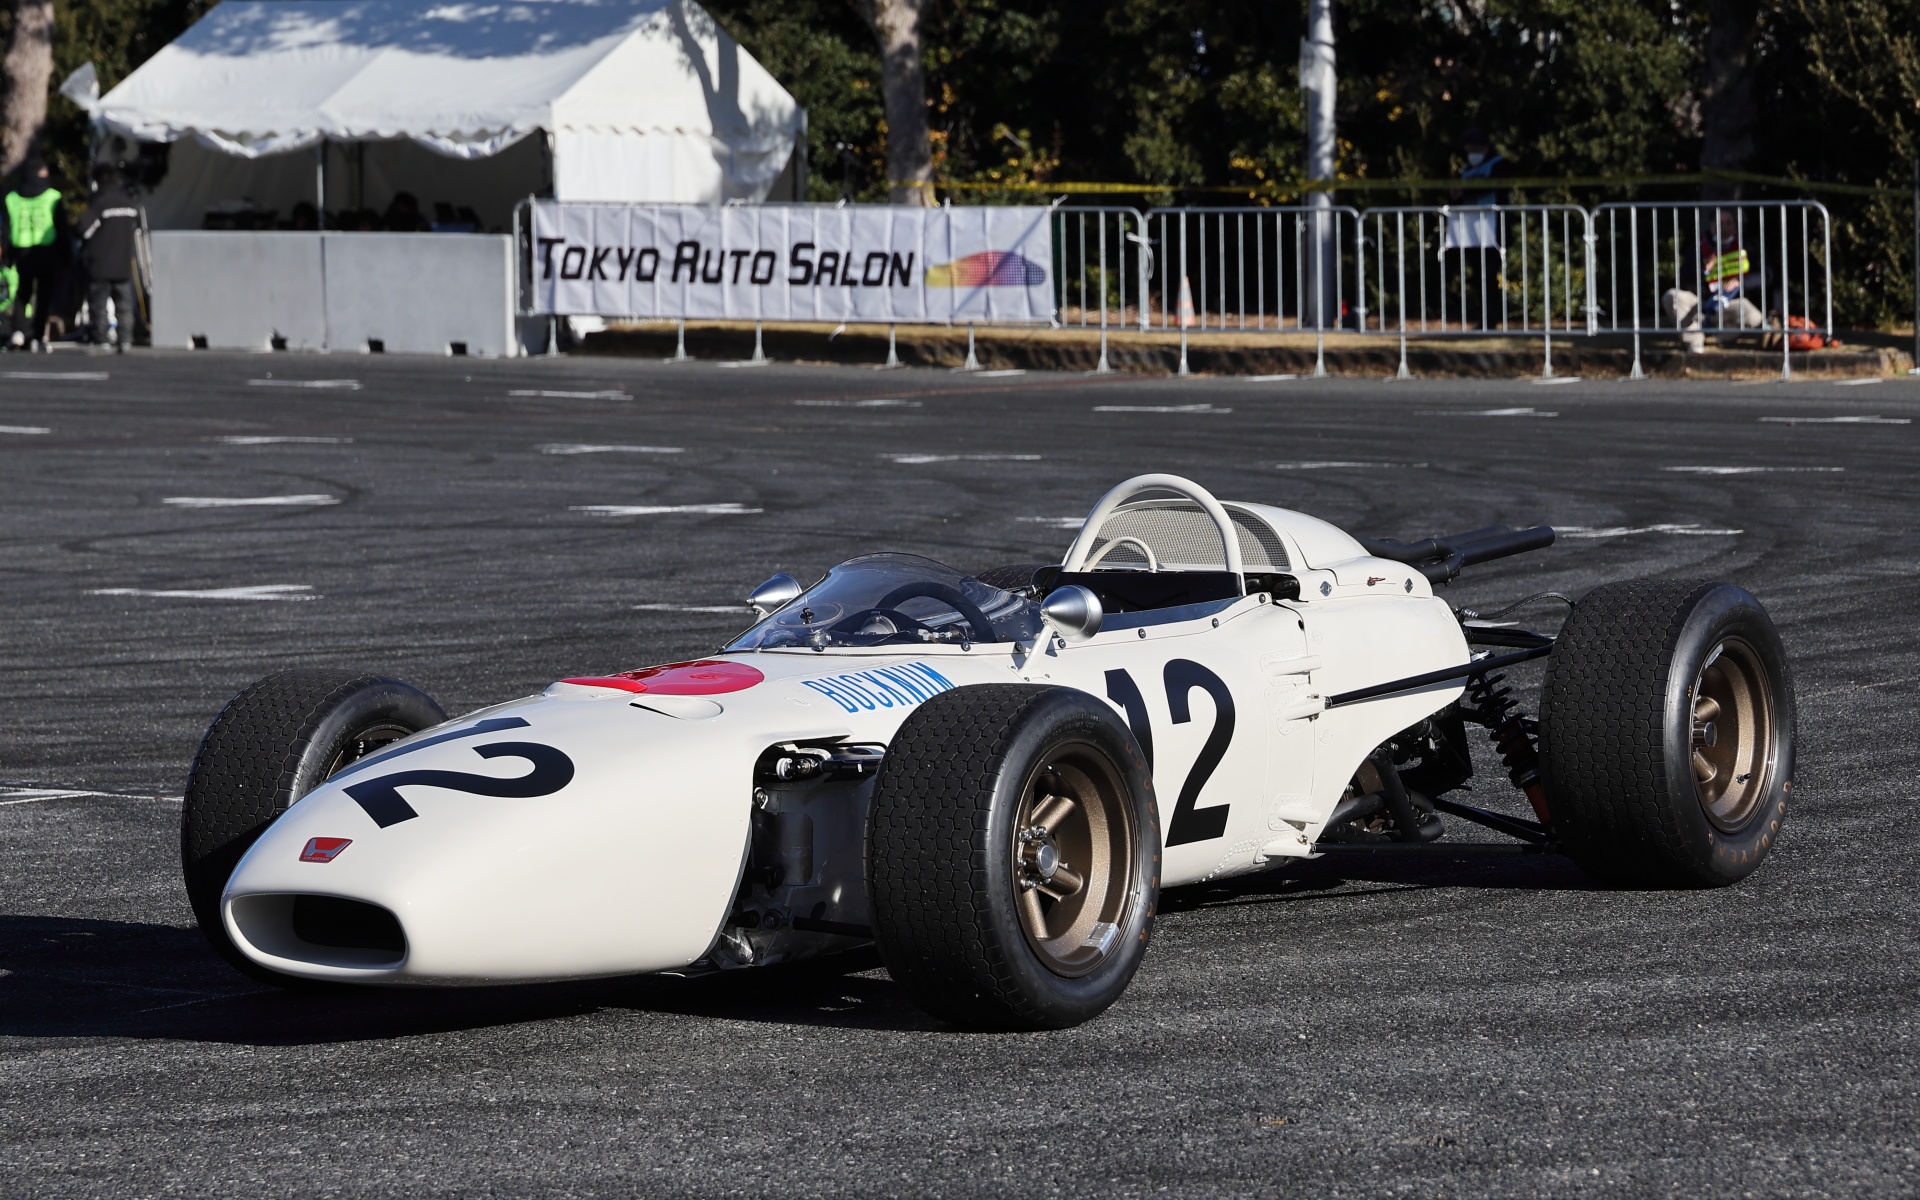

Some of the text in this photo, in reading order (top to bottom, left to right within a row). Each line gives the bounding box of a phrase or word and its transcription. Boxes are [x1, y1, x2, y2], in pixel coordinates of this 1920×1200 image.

[538, 237, 915, 288] TOKYO AUTO SALON
[326, 716, 575, 829] 12
[1103, 658, 1236, 848] 12
